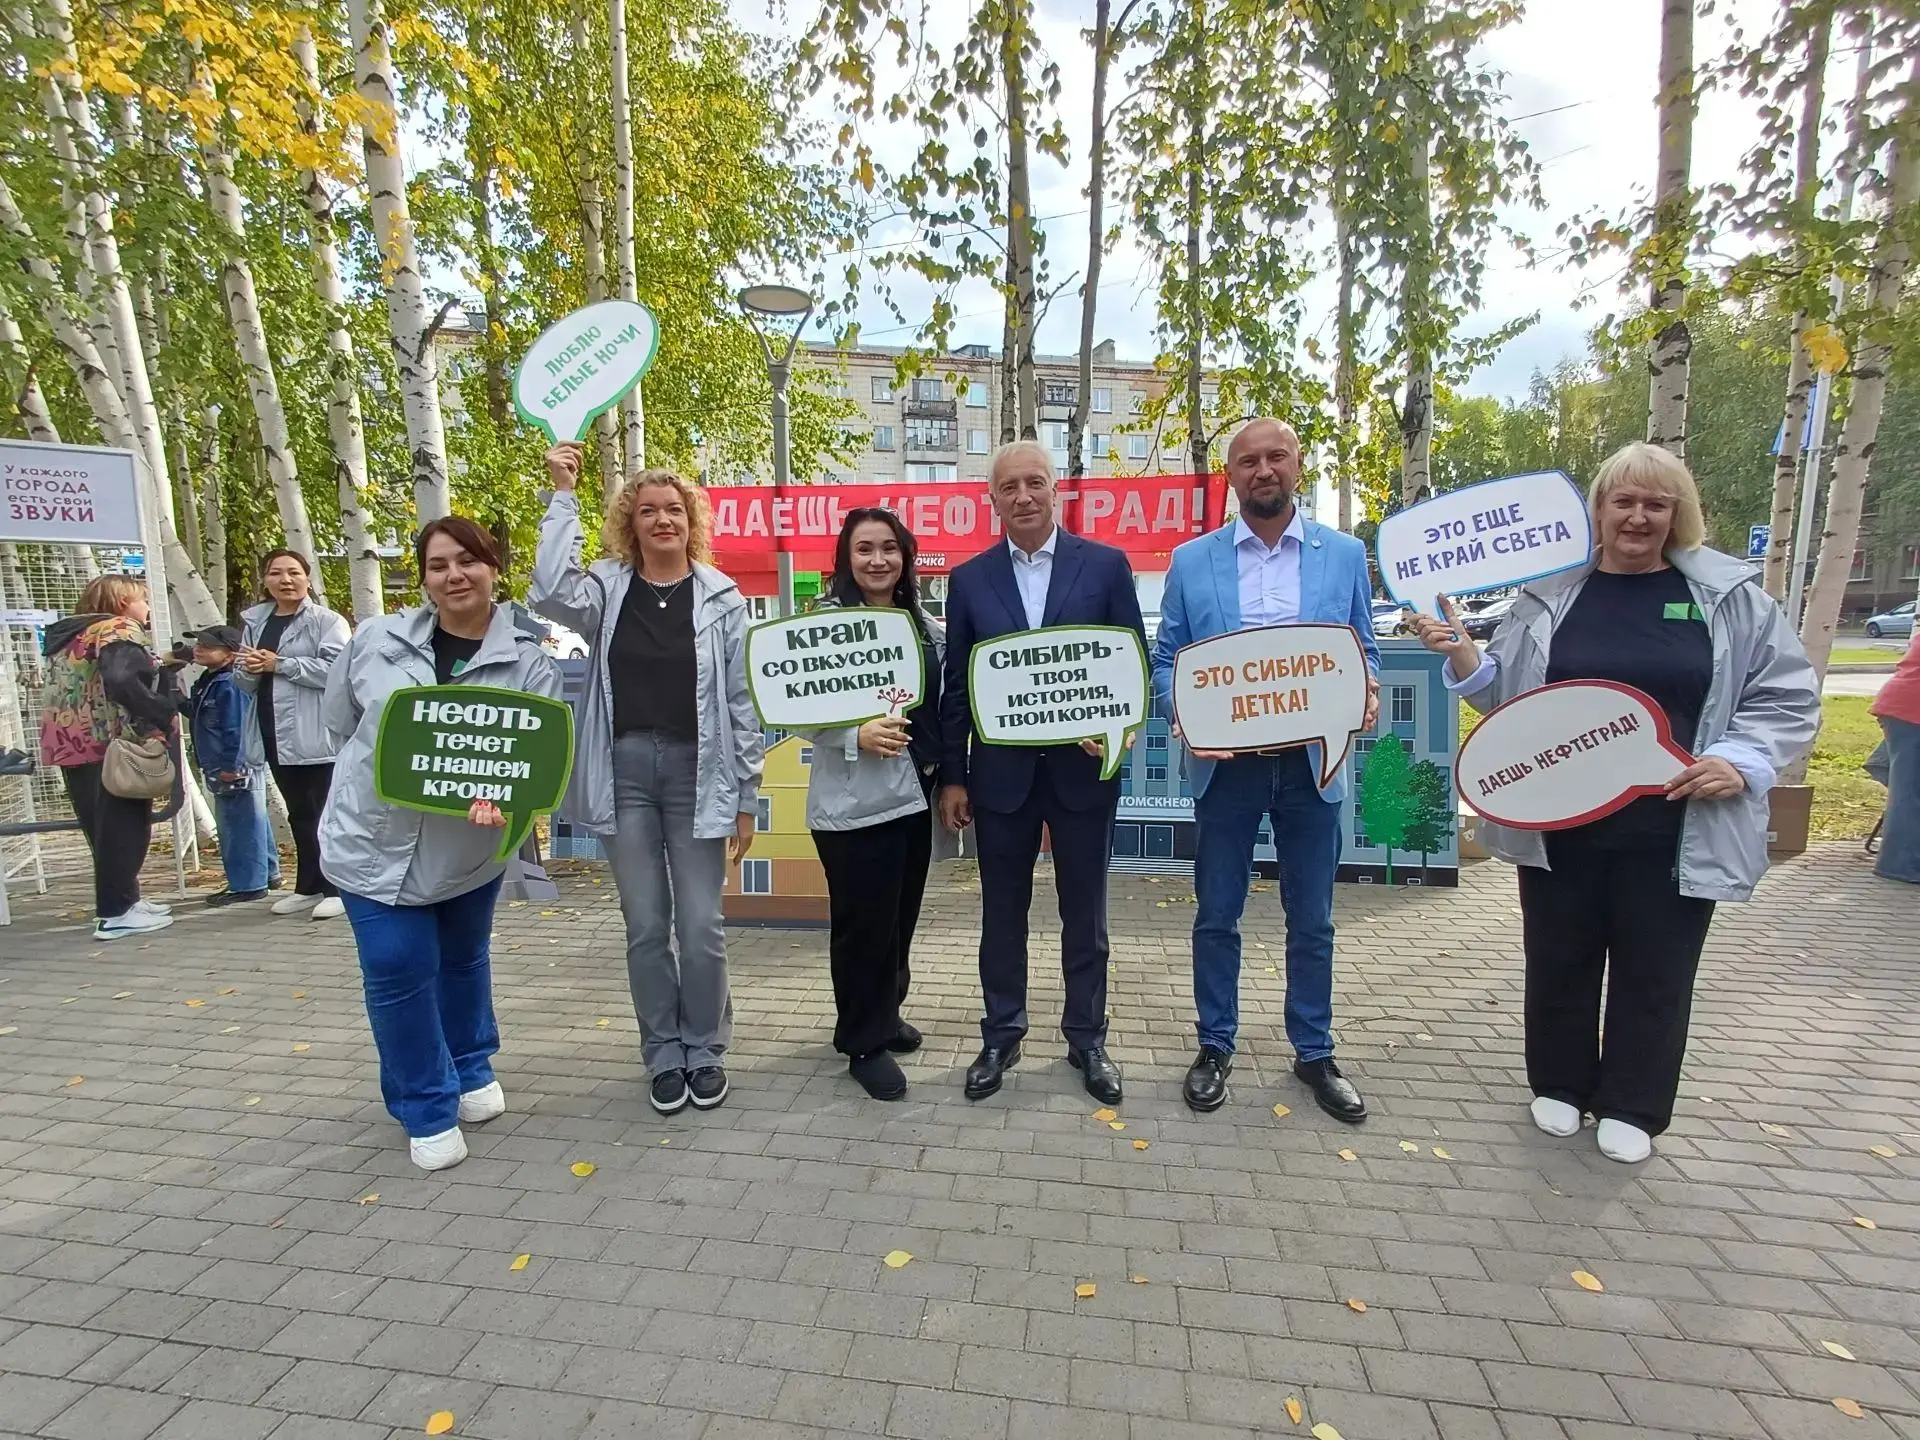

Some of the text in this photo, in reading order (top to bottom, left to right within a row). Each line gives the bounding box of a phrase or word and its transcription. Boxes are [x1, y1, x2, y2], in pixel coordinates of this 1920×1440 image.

[541, 323, 641, 410] БЕЛЫЕ НОЧИ
[544, 326, 602, 378] ЛЮБЛЮ
[5, 464, 89, 479] У каждого
[5, 478, 91, 495] ГОРОДА
[10, 504, 95, 522] ЗВУКИ
[1424, 503, 1524, 544] ЭТО ЕЩЕ
[1395, 520, 1571, 580] НЕ КРАЙ СВЕТА
[989, 641, 1112, 670] СИБИРЬ
[1029, 668, 1088, 686] ТВОЯ
[1192, 653, 1343, 689] ЭТО СИБИРЬ,
[1007, 685, 1114, 708] ИСТОРИЯ,
[1231, 688, 1309, 722] ДЕТКА!
[995, 703, 1131, 728] ТВОИ КОРНИ
[1477, 713, 1641, 797] ДАЕШЬ НЕФТЕГРАД!
[1119, 796, 1195, 808] ТОМСКНЕФТ
